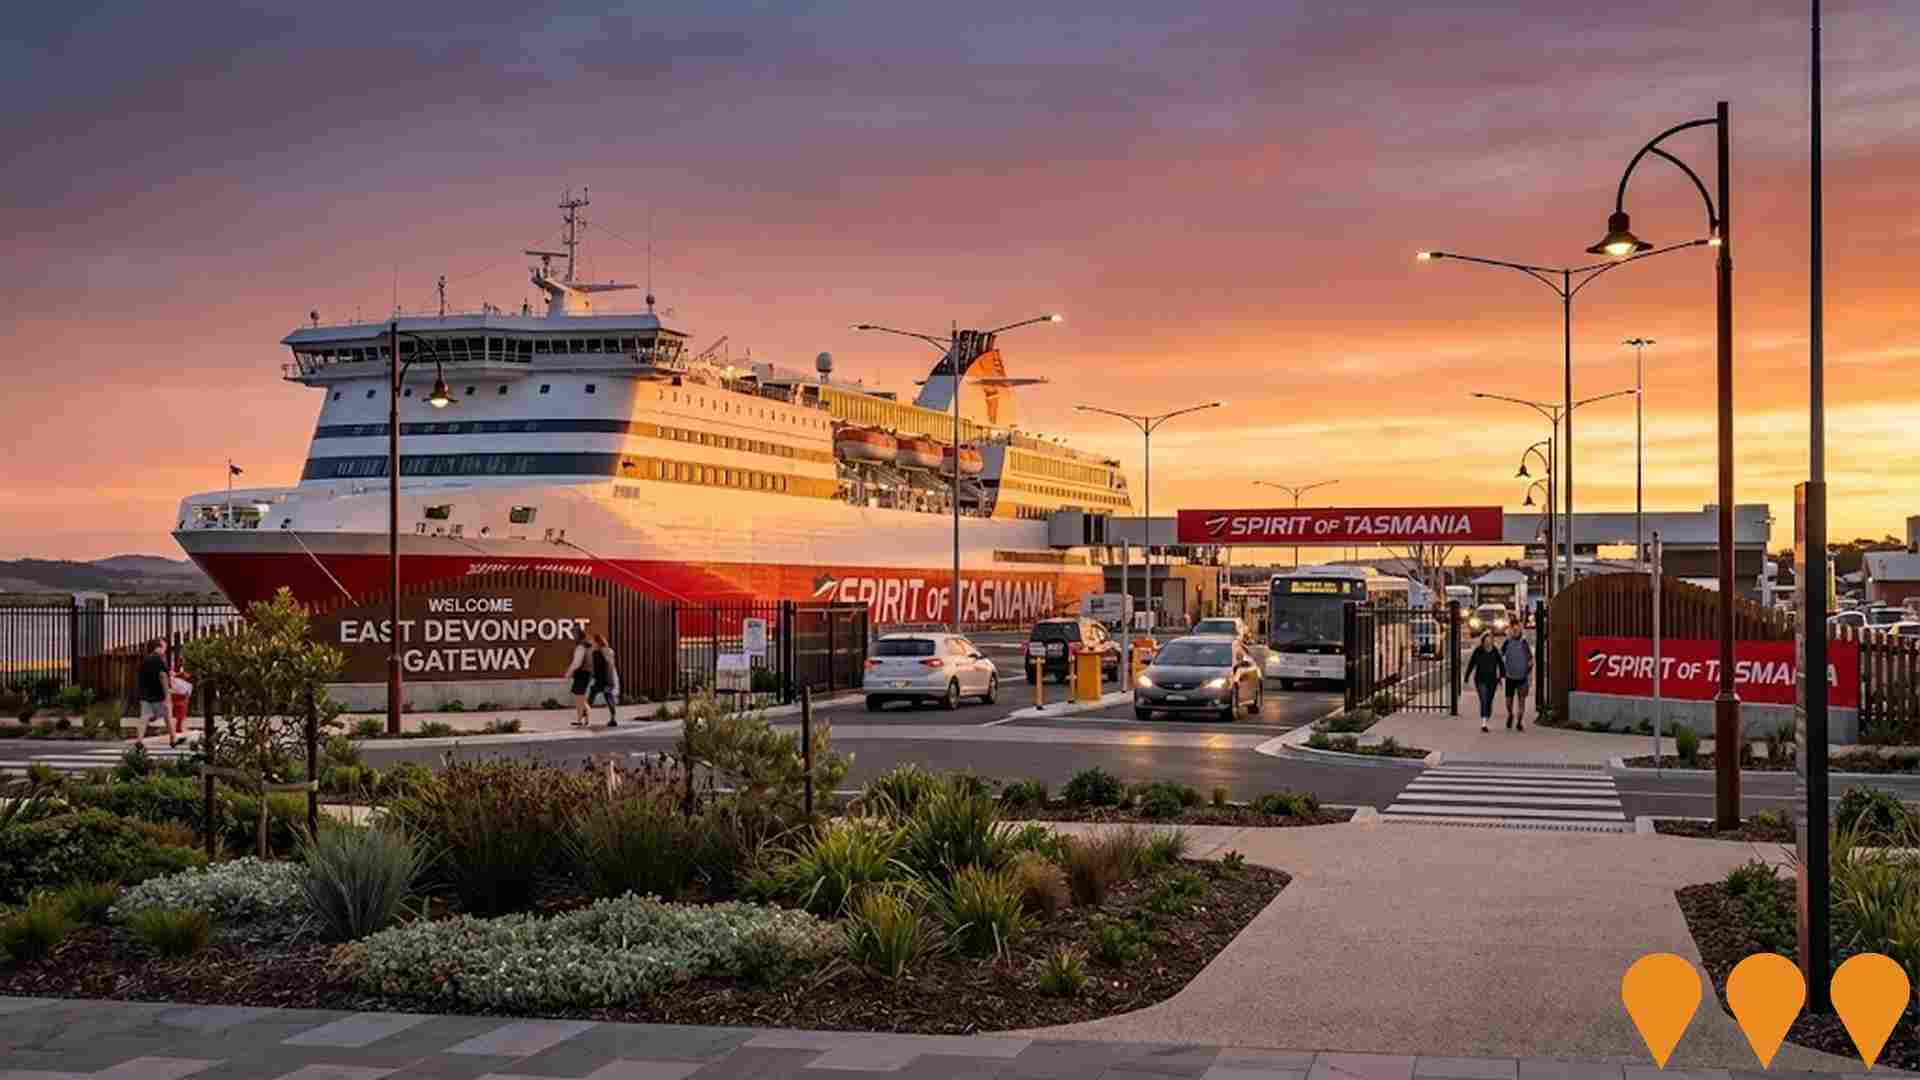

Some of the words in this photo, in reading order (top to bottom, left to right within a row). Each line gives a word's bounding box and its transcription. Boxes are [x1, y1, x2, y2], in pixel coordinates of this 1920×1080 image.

[1231, 516, 1311, 535] SPIRIT
[1314, 519, 1340, 534] OF
[1344, 515, 1473, 534] TASMANIA
[926, 586, 949, 621] OF
[403, 647, 535, 672] GATEWAY
[1607, 655, 1675, 679] SPIRT
[1677, 662, 1700, 680] OF
[1703, 660, 1838, 687] TSMAA
